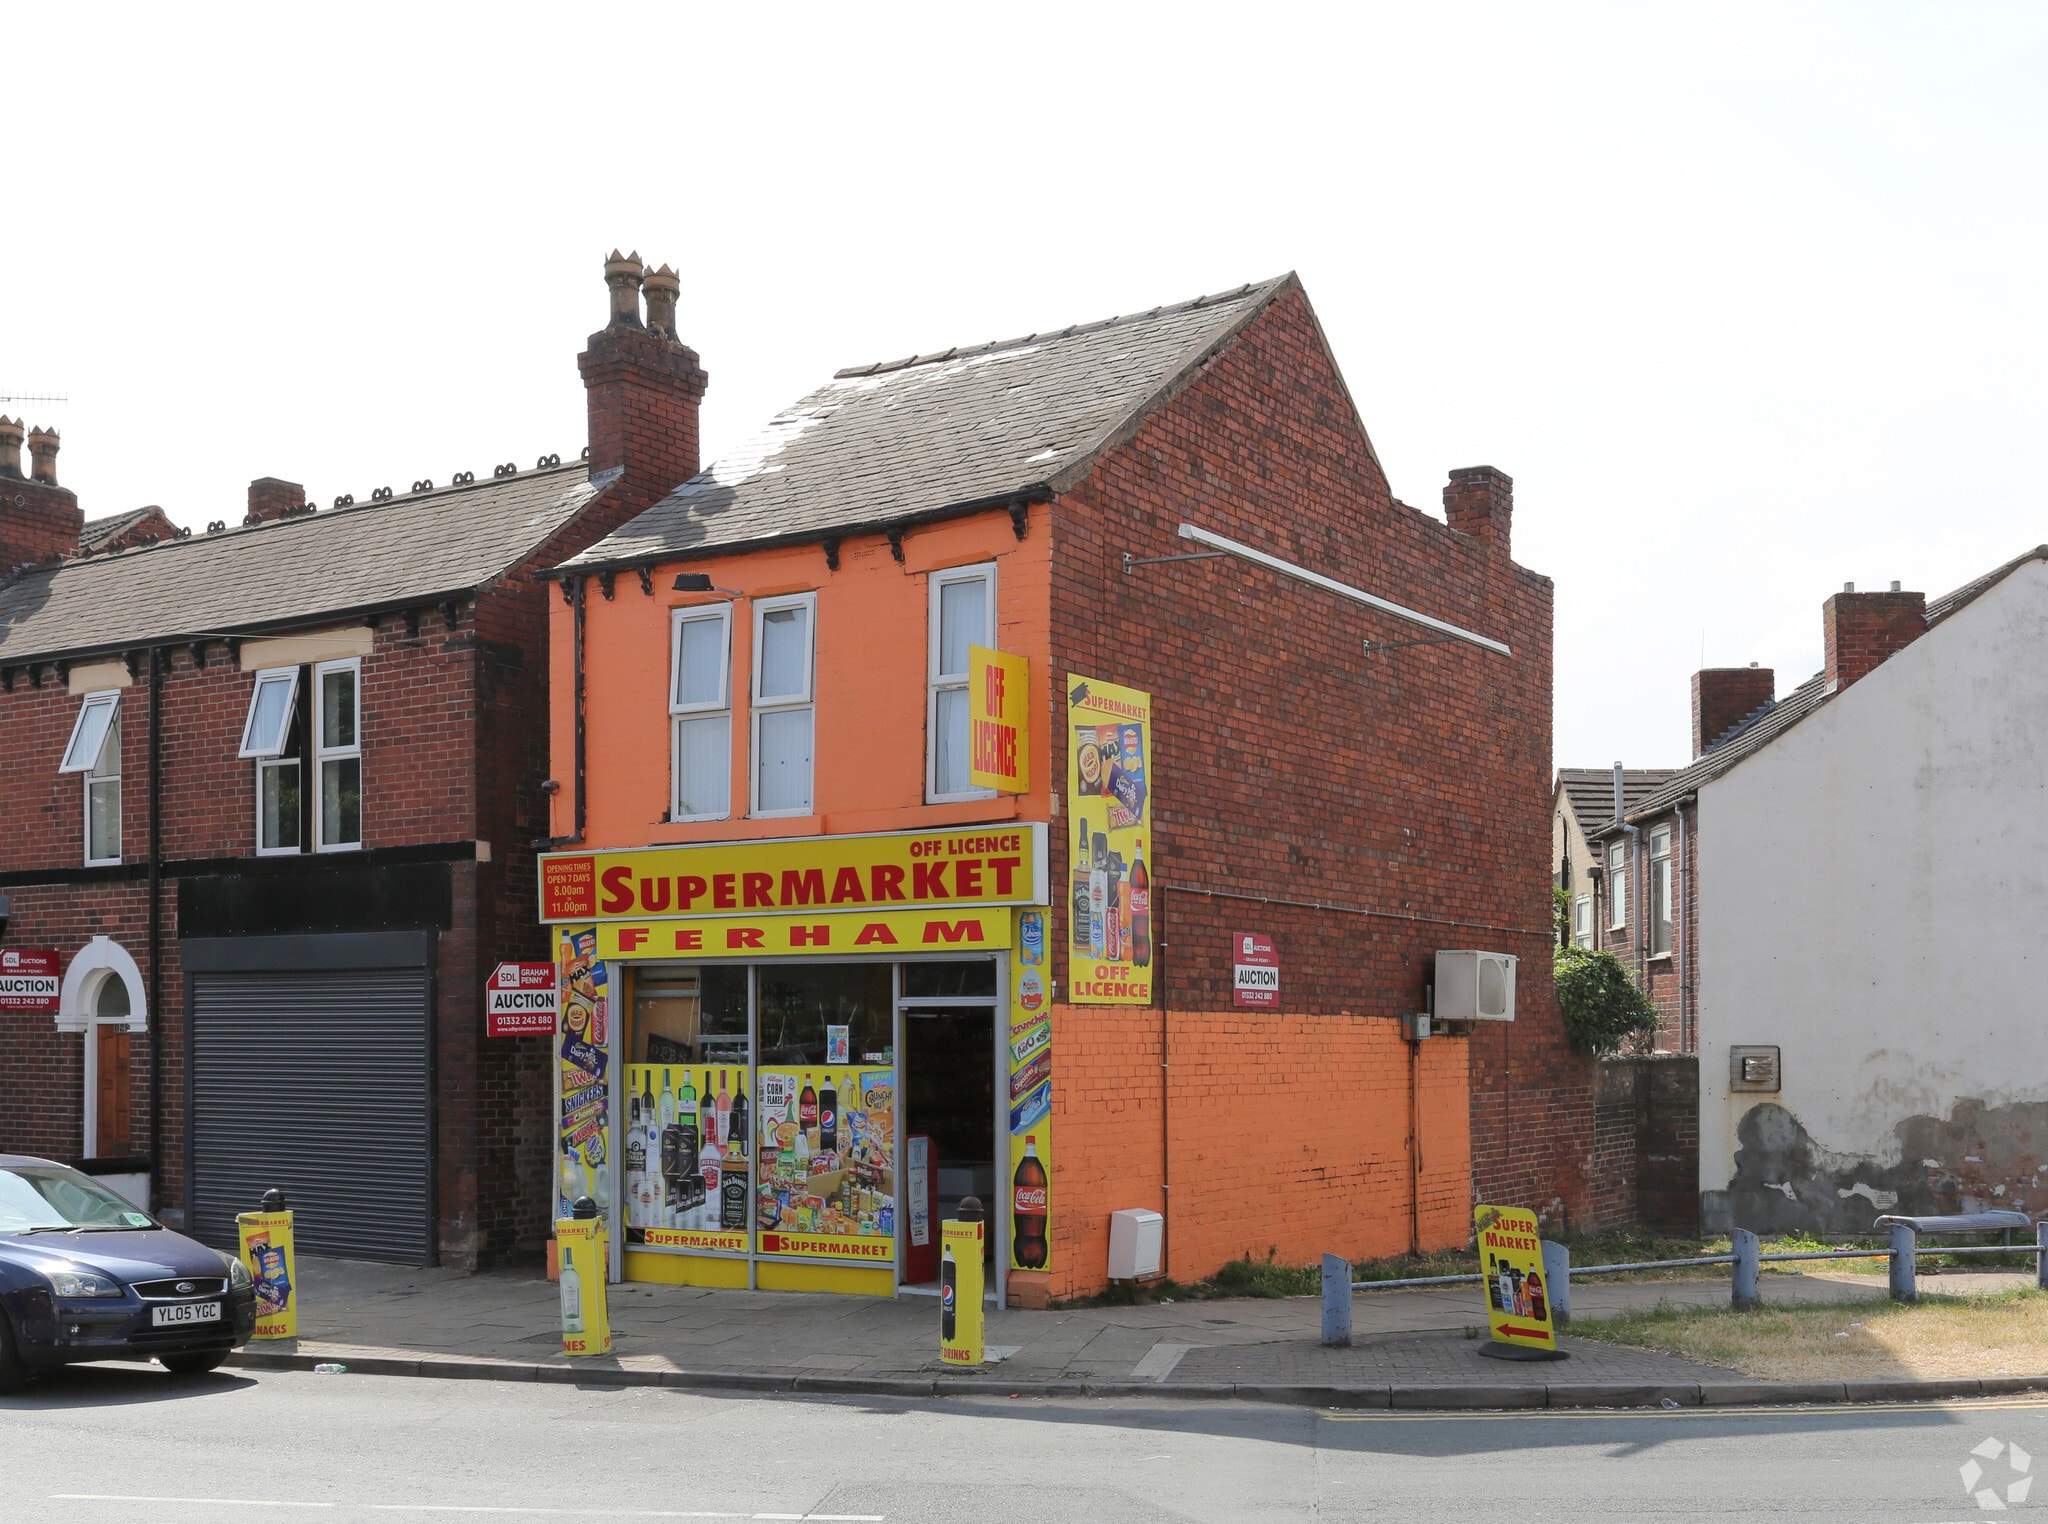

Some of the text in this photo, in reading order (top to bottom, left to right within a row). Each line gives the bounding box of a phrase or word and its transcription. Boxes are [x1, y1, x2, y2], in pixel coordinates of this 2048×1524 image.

[986, 664, 1005, 719] OFF
[1084, 689, 1147, 720] SUPERMARKET
[974, 719, 1017, 778] LICENCE
[910, 835, 1020, 857] OFF LICENCE
[547, 863, 591, 873] OPENING TIMES
[547, 874, 591, 884] OPEN 7 DAYS
[601, 857, 1021, 913] SUPERMARKET
[554, 885, 584, 896] 8.00am
[552, 902, 588, 914] 11.00pm
[618, 920, 985, 952] FERHAM
[501, 973, 517, 982] SDL
[1095, 965, 1130, 981] OFF
[1239, 970, 1276, 985] AUCTION
[1075, 982, 1148, 998] LICENCE
[495, 993, 555, 1008] AUCTION
[497, 1016, 552, 1025] 01332 242 880
[570, 1045, 584, 1060] Dairy
[767, 1083, 783, 1095] CORN
[565, 1084, 603, 1112] SNICKERS
[767, 1096, 783, 1105] FLAKES
[1016, 1188, 1046, 1204] Coca-Cola
[1493, 1213, 1534, 1233] SUPER
[645, 1231, 743, 1248] SUPERMARKET
[780, 1237, 888, 1256] SUPERMARKET
[1485, 1232, 1537, 1251] MARKET
[159, 1304, 216, 1322] YL05 YGC
[563, 1340, 586, 1351] NES
[944, 1348, 971, 1361] DRINKS
